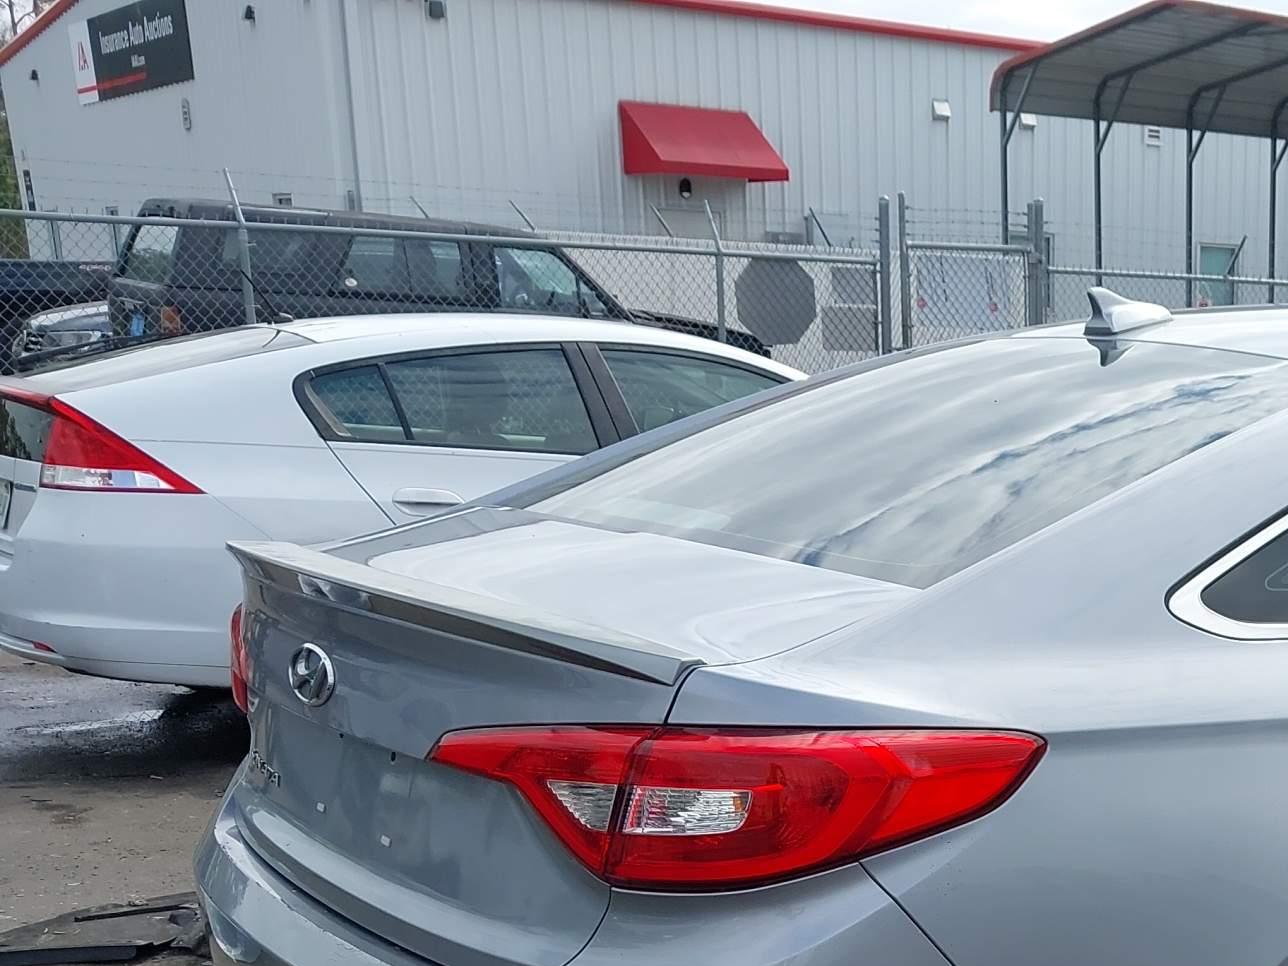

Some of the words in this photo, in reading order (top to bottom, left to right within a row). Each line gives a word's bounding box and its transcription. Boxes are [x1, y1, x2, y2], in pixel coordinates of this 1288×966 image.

[98, 31, 129, 55] Insurance
[128, 21, 144, 47] Auto
[143, 11, 173, 42] Auctions
